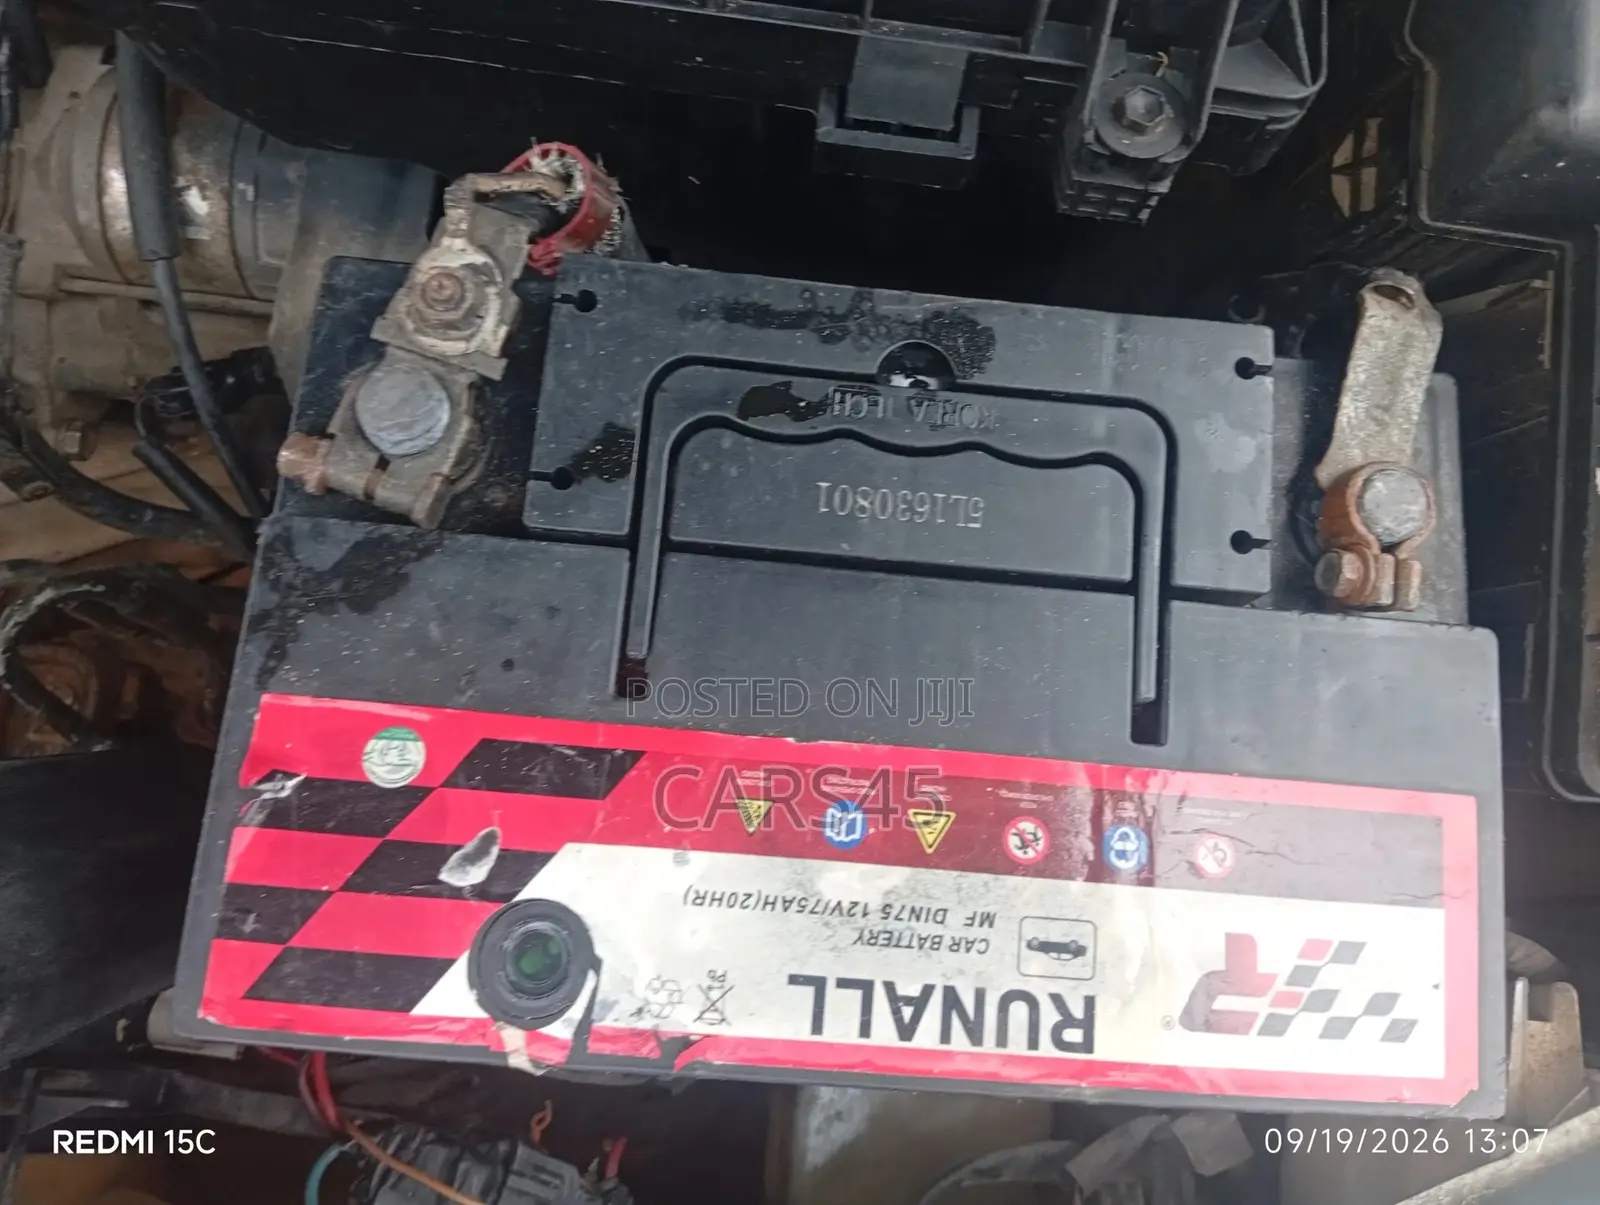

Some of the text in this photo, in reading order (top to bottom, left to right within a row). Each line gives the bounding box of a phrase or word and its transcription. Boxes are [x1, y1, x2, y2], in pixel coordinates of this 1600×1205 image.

[816, 482, 986, 528] 5L1630801
[682, 884, 997, 928] MF DIN75 12V/75AH(20HR)
[851, 929, 991, 955] CAR BATTERY
[787, 973, 1097, 1054] RUNALL
